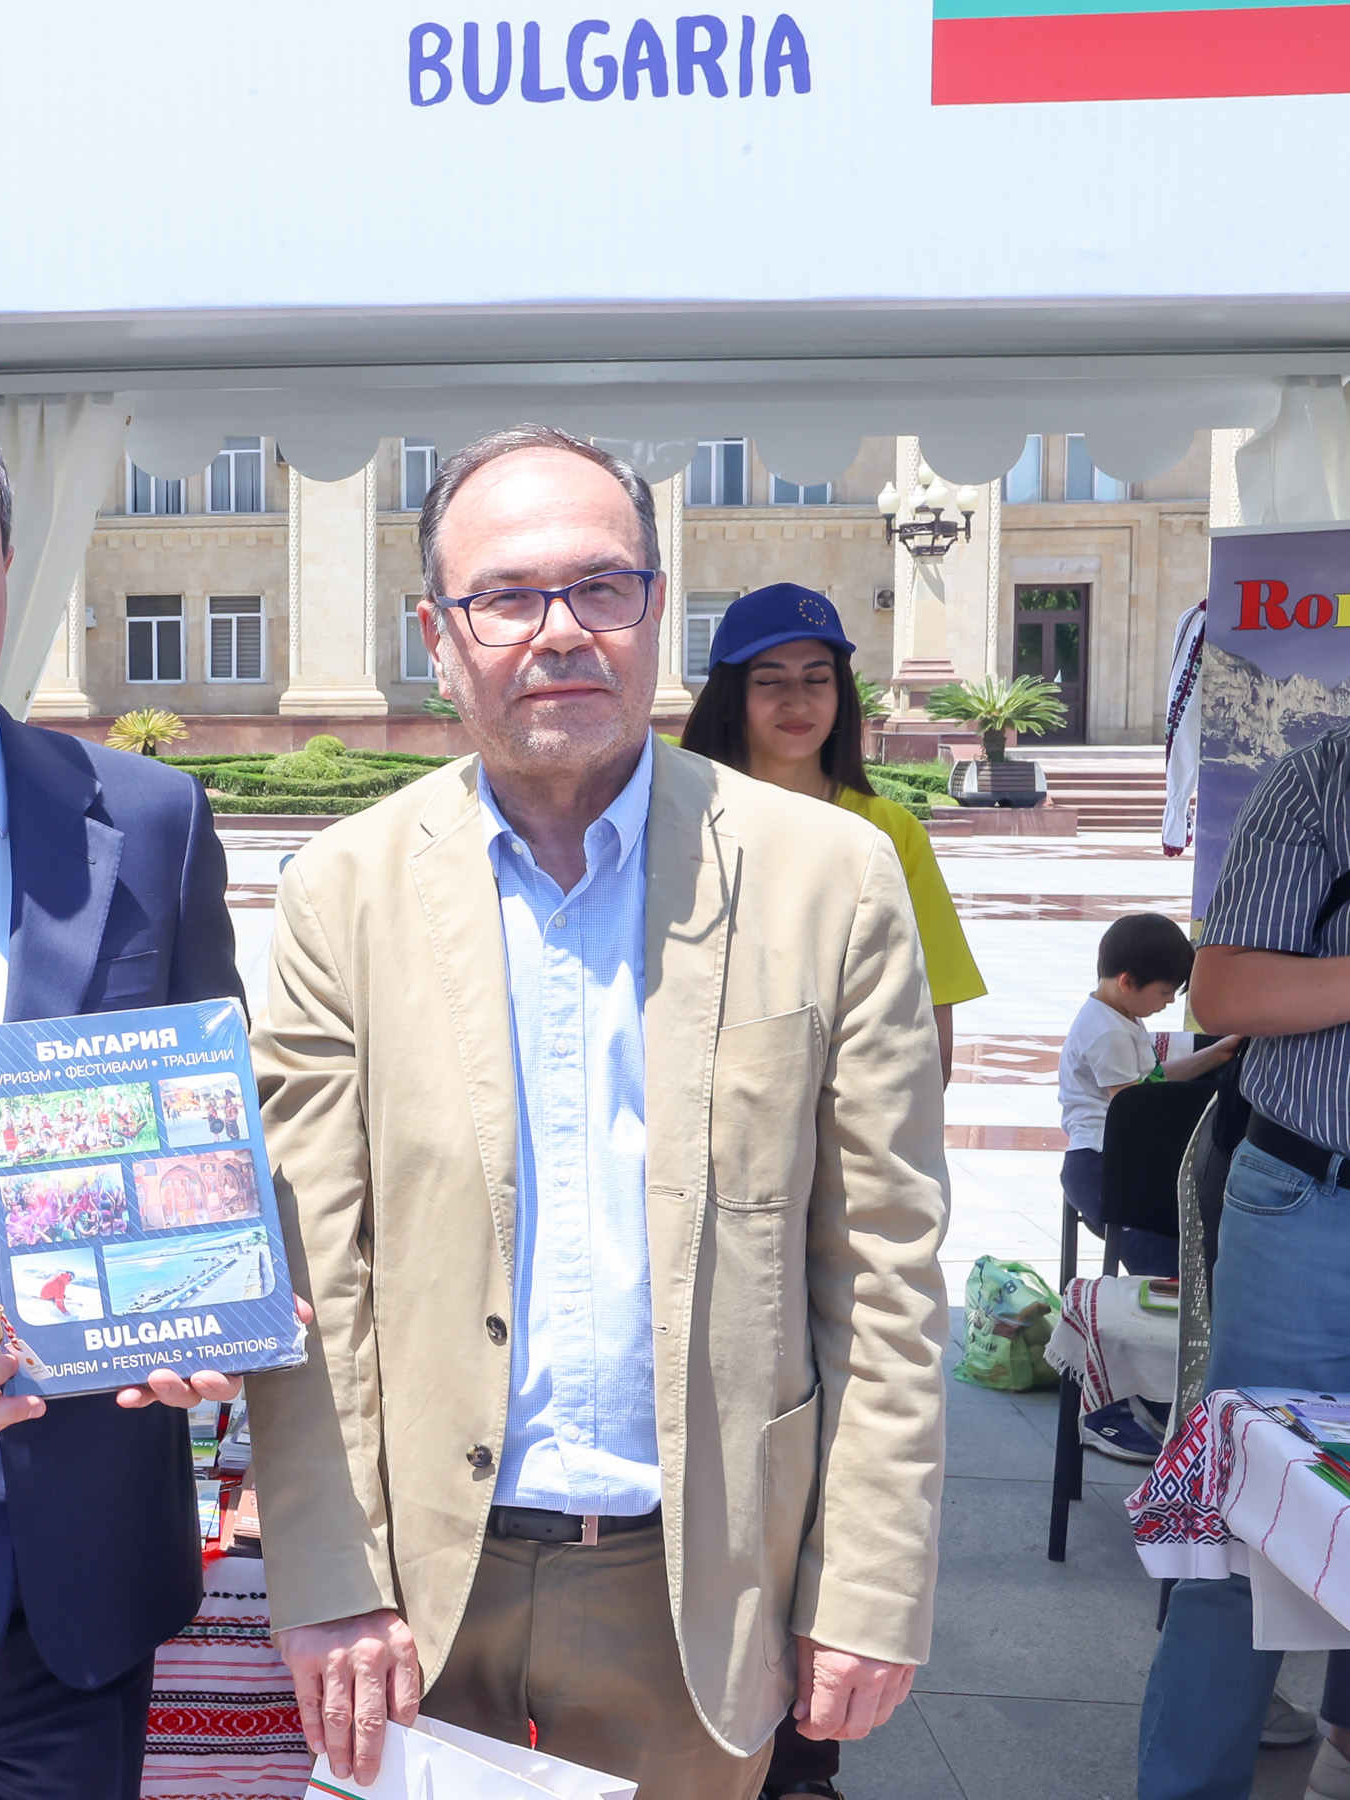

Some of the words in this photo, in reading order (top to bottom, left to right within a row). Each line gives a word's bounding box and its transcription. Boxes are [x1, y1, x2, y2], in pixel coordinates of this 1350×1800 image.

[409, 14, 812, 107] BULGARIA
[35, 1027, 178, 1062] БЪЛГАРИЯ
[65, 1058, 149, 1080] ФЕСТИВАЛИ
[161, 1049, 234, 1068] ТРАДИЦИИ
[83, 1314, 222, 1351] BULGARIA
[112, 1350, 183, 1370] FESTIVALS
[196, 1336, 278, 1359] TRADITIONS
